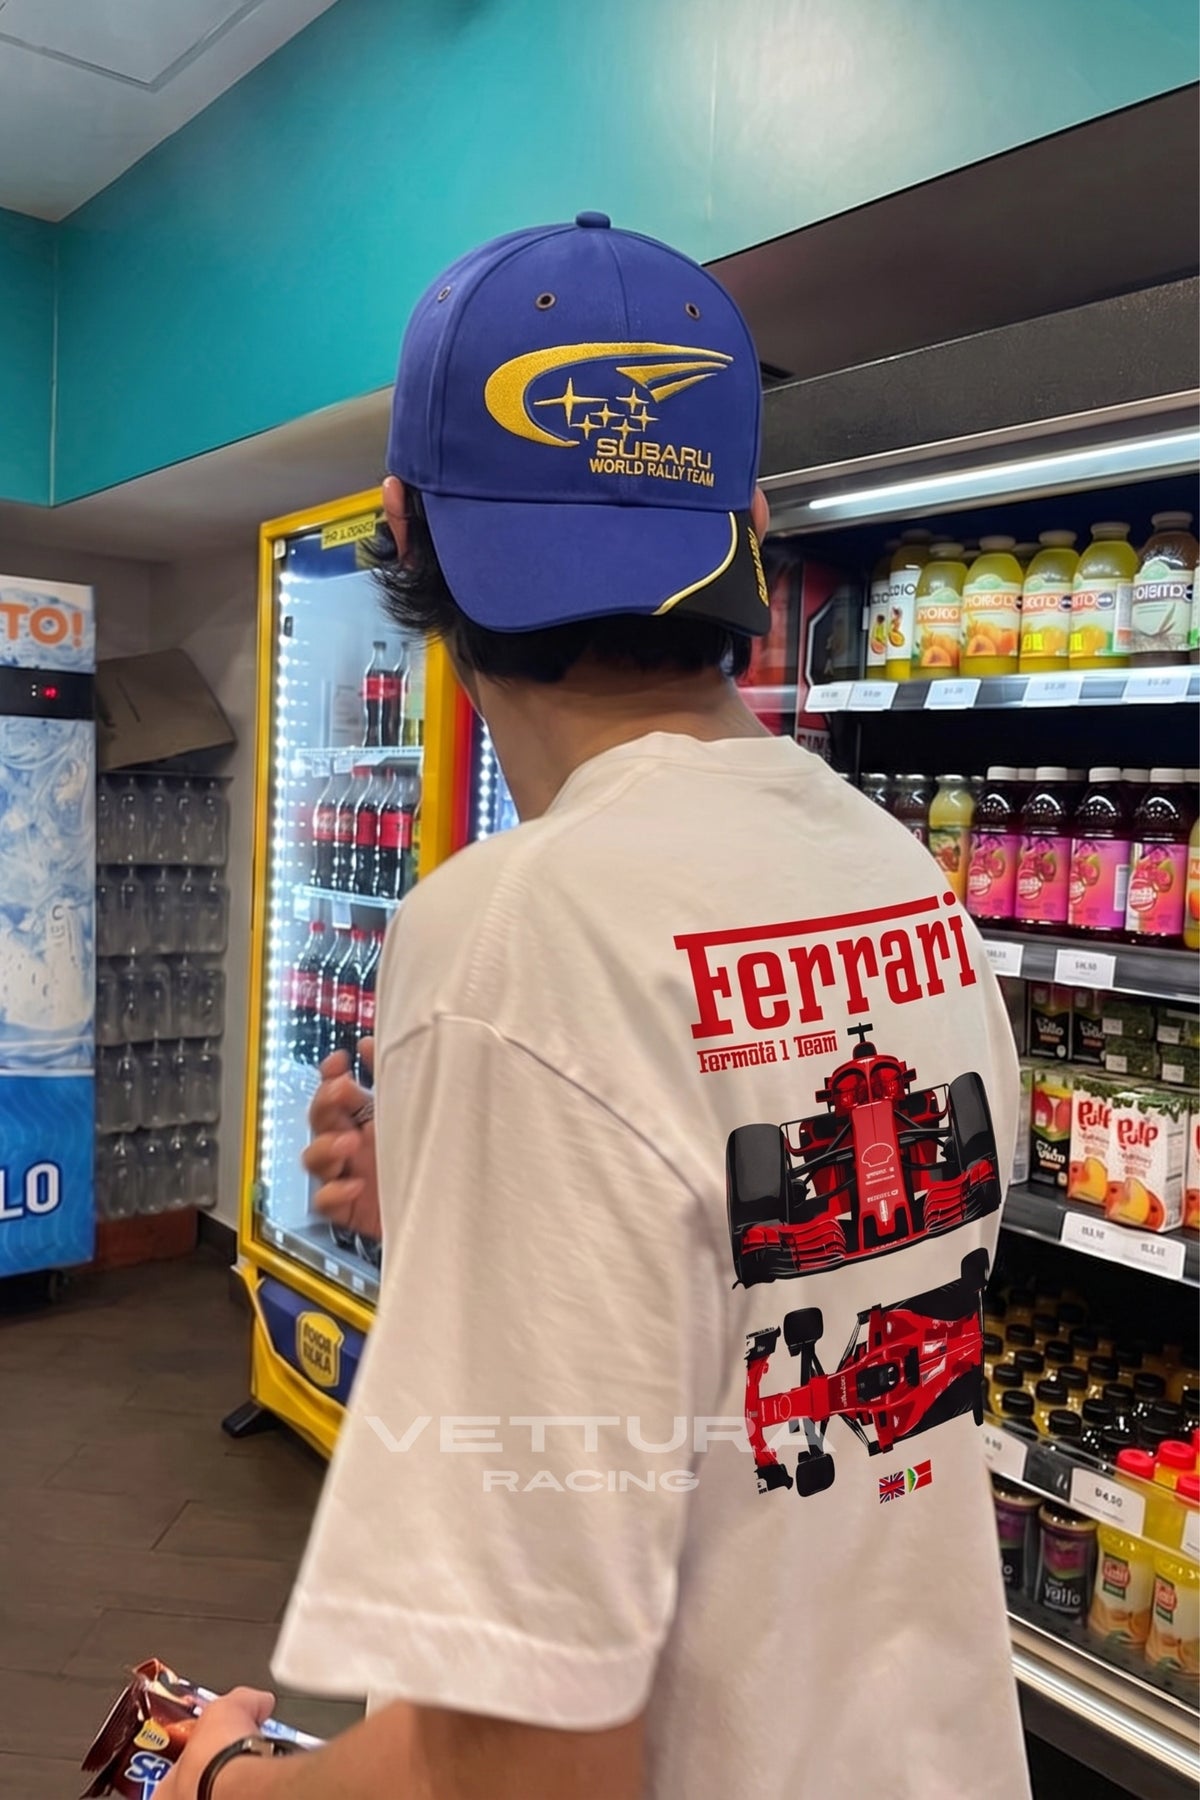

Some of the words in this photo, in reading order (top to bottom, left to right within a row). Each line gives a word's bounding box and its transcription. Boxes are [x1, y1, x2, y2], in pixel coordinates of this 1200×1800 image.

[596, 438, 712, 469] SUBARU
[589, 458, 645, 475] WORLD
[647, 462, 686, 481] RALLY
[686, 468, 715, 487] TEAM
[673, 891, 978, 1040] Ferrari
[779, 1039, 790, 1060] 1
[793, 1030, 838, 1058] Team
